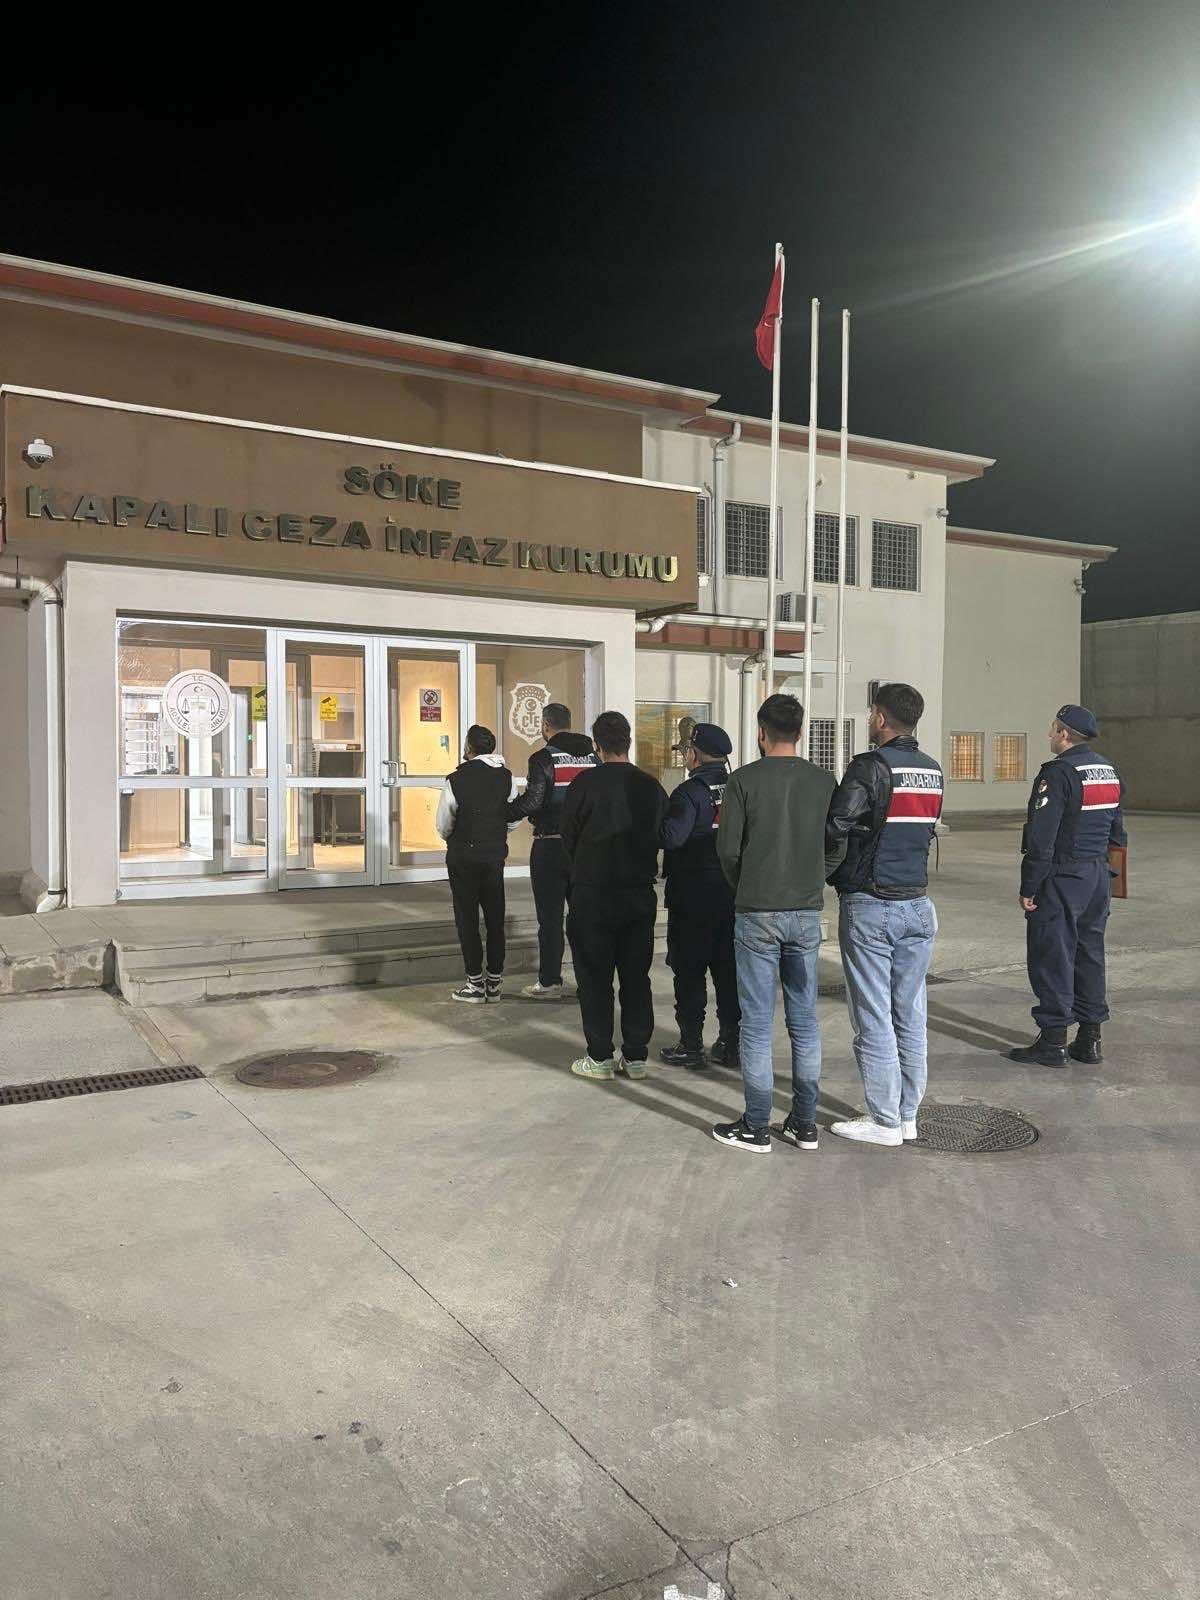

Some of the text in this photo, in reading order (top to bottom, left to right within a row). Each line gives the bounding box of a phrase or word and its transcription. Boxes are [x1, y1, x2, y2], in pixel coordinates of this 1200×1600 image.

[344, 463, 463, 509] SÖKE
[26, 485, 678, 582] KAPALI CEZA İNFAZ KURUMU
[522, 711, 540, 728] CTE
[901, 773, 941, 789] JANDARMA
[1086, 768, 1118, 780] JANDARMA
